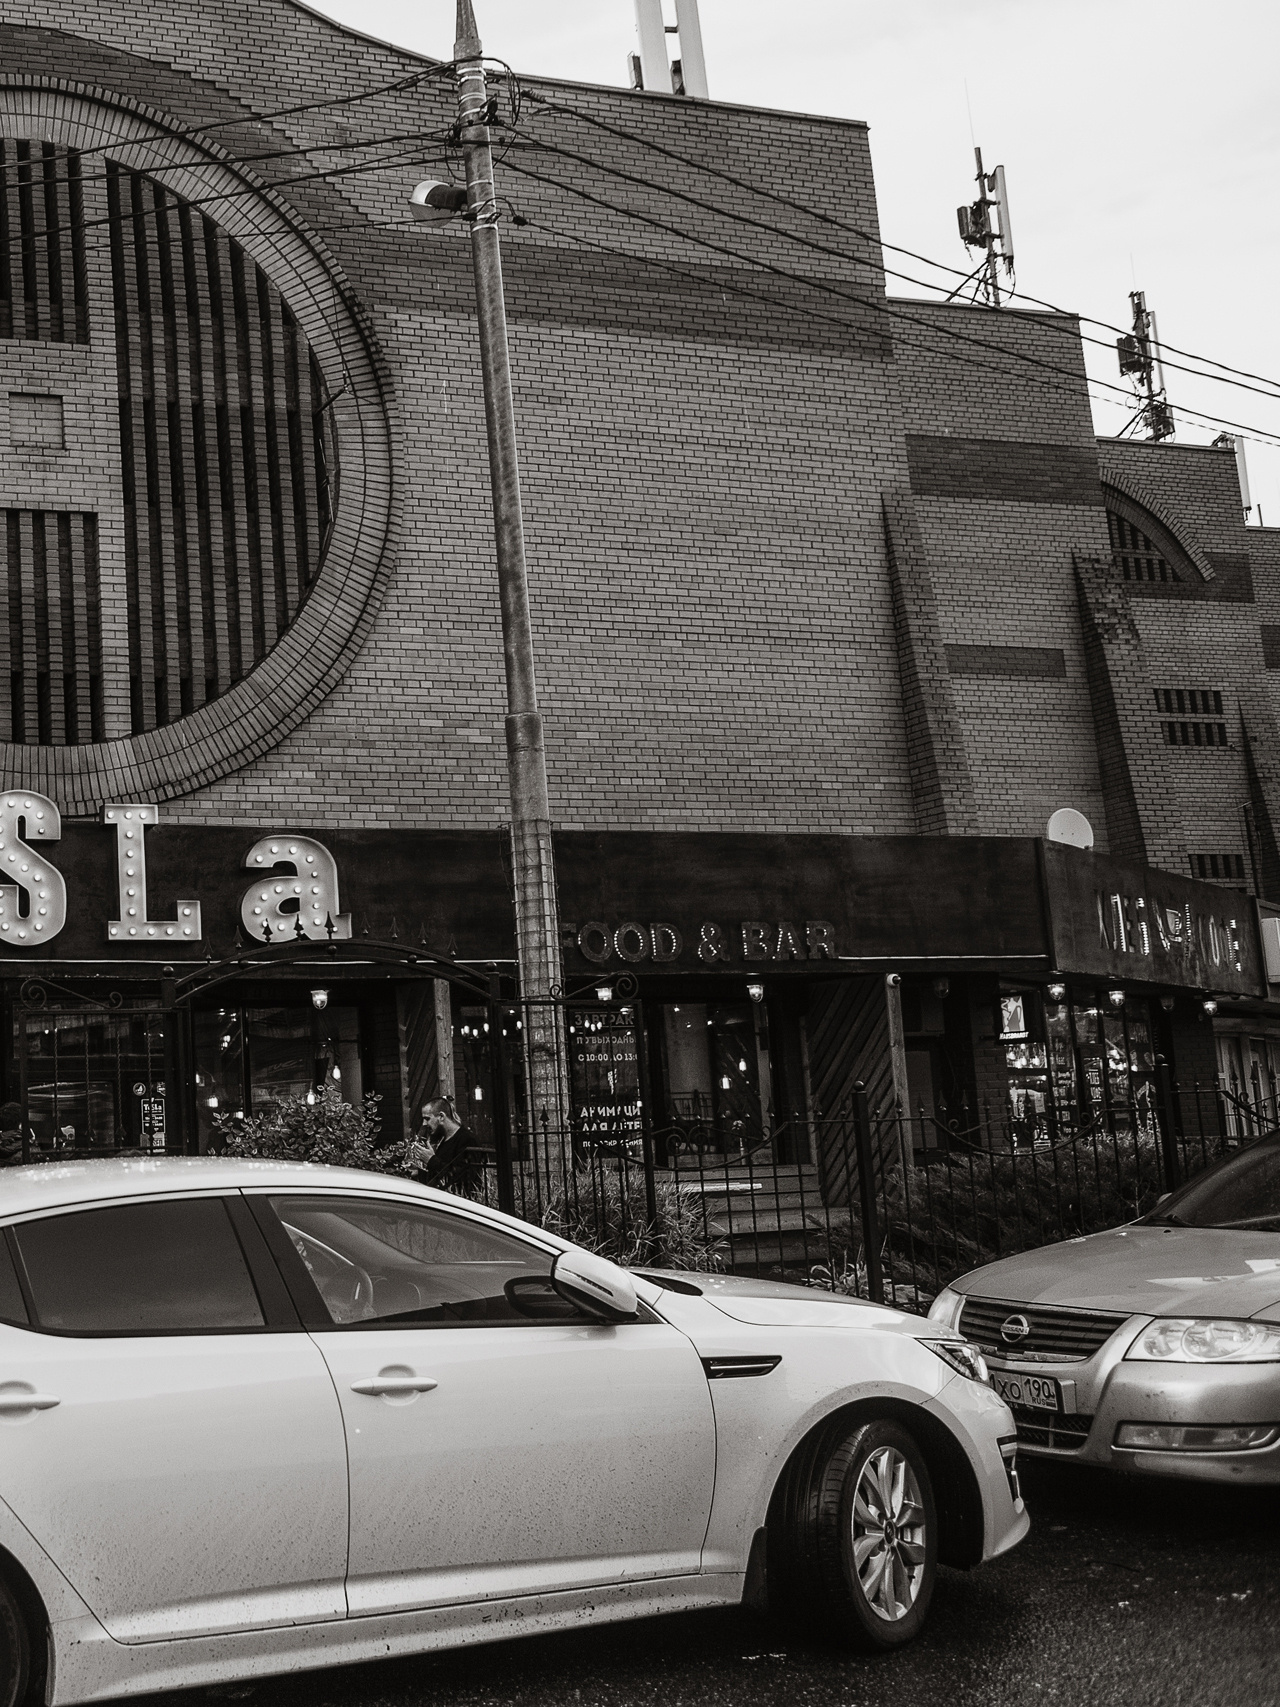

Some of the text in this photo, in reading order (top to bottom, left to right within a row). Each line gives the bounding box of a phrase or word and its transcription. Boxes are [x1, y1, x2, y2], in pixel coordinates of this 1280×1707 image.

[698, 921, 730, 963] &
[740, 920, 840, 961] BAR
[586, 1053, 608, 1061] 10:00
[1024, 1377, 1051, 1398] 190
[1032, 1396, 1047, 1406] RUS
